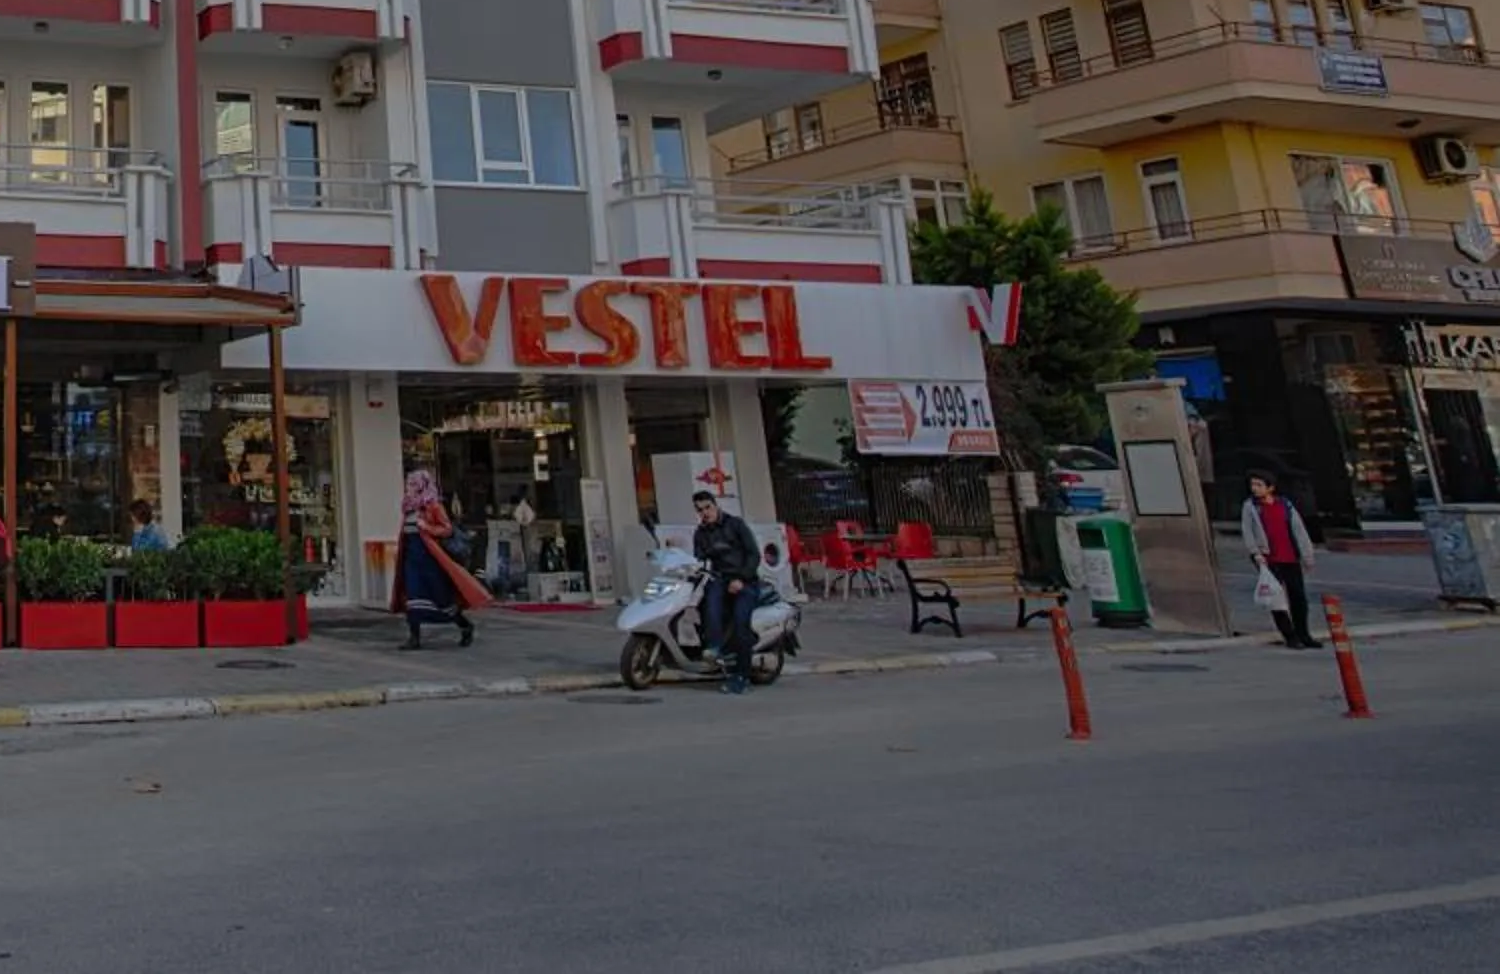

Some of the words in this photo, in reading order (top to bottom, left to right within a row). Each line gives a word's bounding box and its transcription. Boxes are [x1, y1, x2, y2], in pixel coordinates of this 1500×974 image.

[420, 274, 832, 369] VESTEL
[915, 385, 968, 427] 2.999
[971, 398, 991, 427] TL
